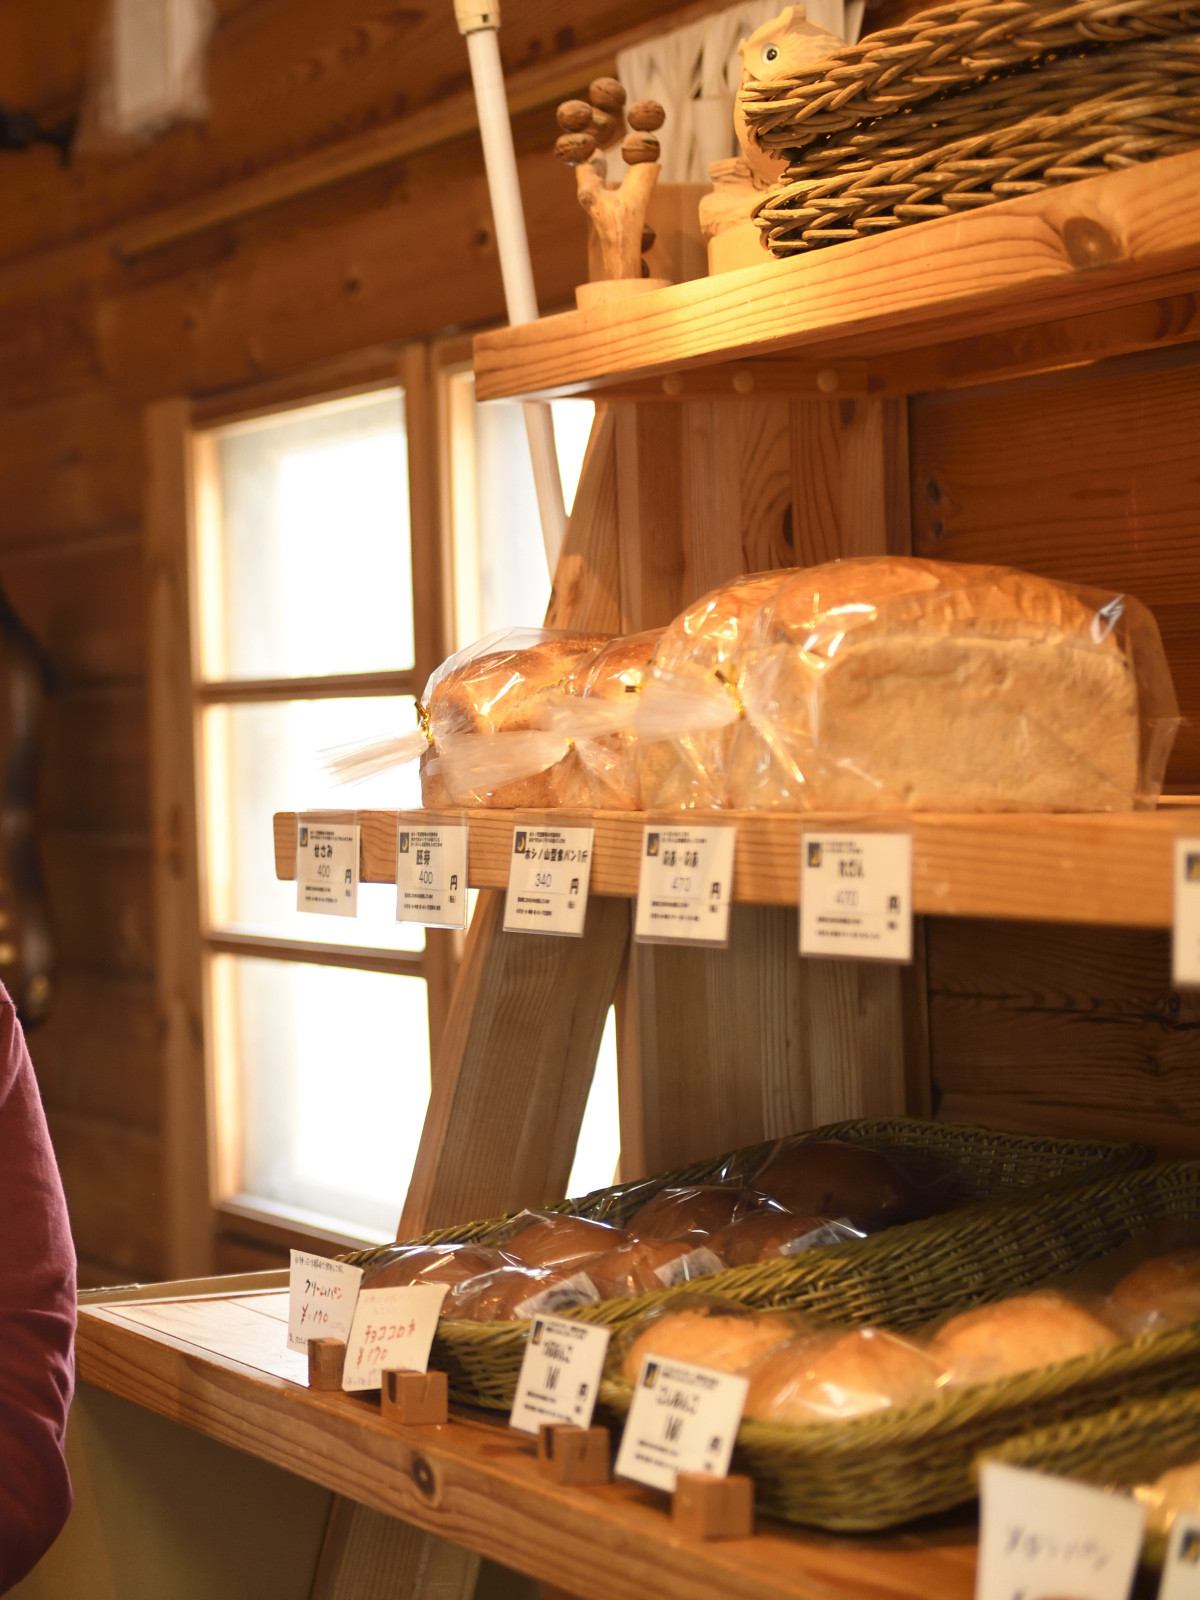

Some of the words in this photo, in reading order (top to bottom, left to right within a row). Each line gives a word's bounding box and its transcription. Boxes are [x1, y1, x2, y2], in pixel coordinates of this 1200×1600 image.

[314, 844, 333, 858] せさみ
[416, 849, 431, 865] 胚芽
[316, 864, 331, 878] 400
[344, 868, 352, 884] 円
[418, 869, 433, 885] 400
[449, 874, 458, 891] 円
[535, 873, 553, 888] 340
[569, 877, 579, 895] 円
[364, 1316, 417, 1345] チョココロネ
